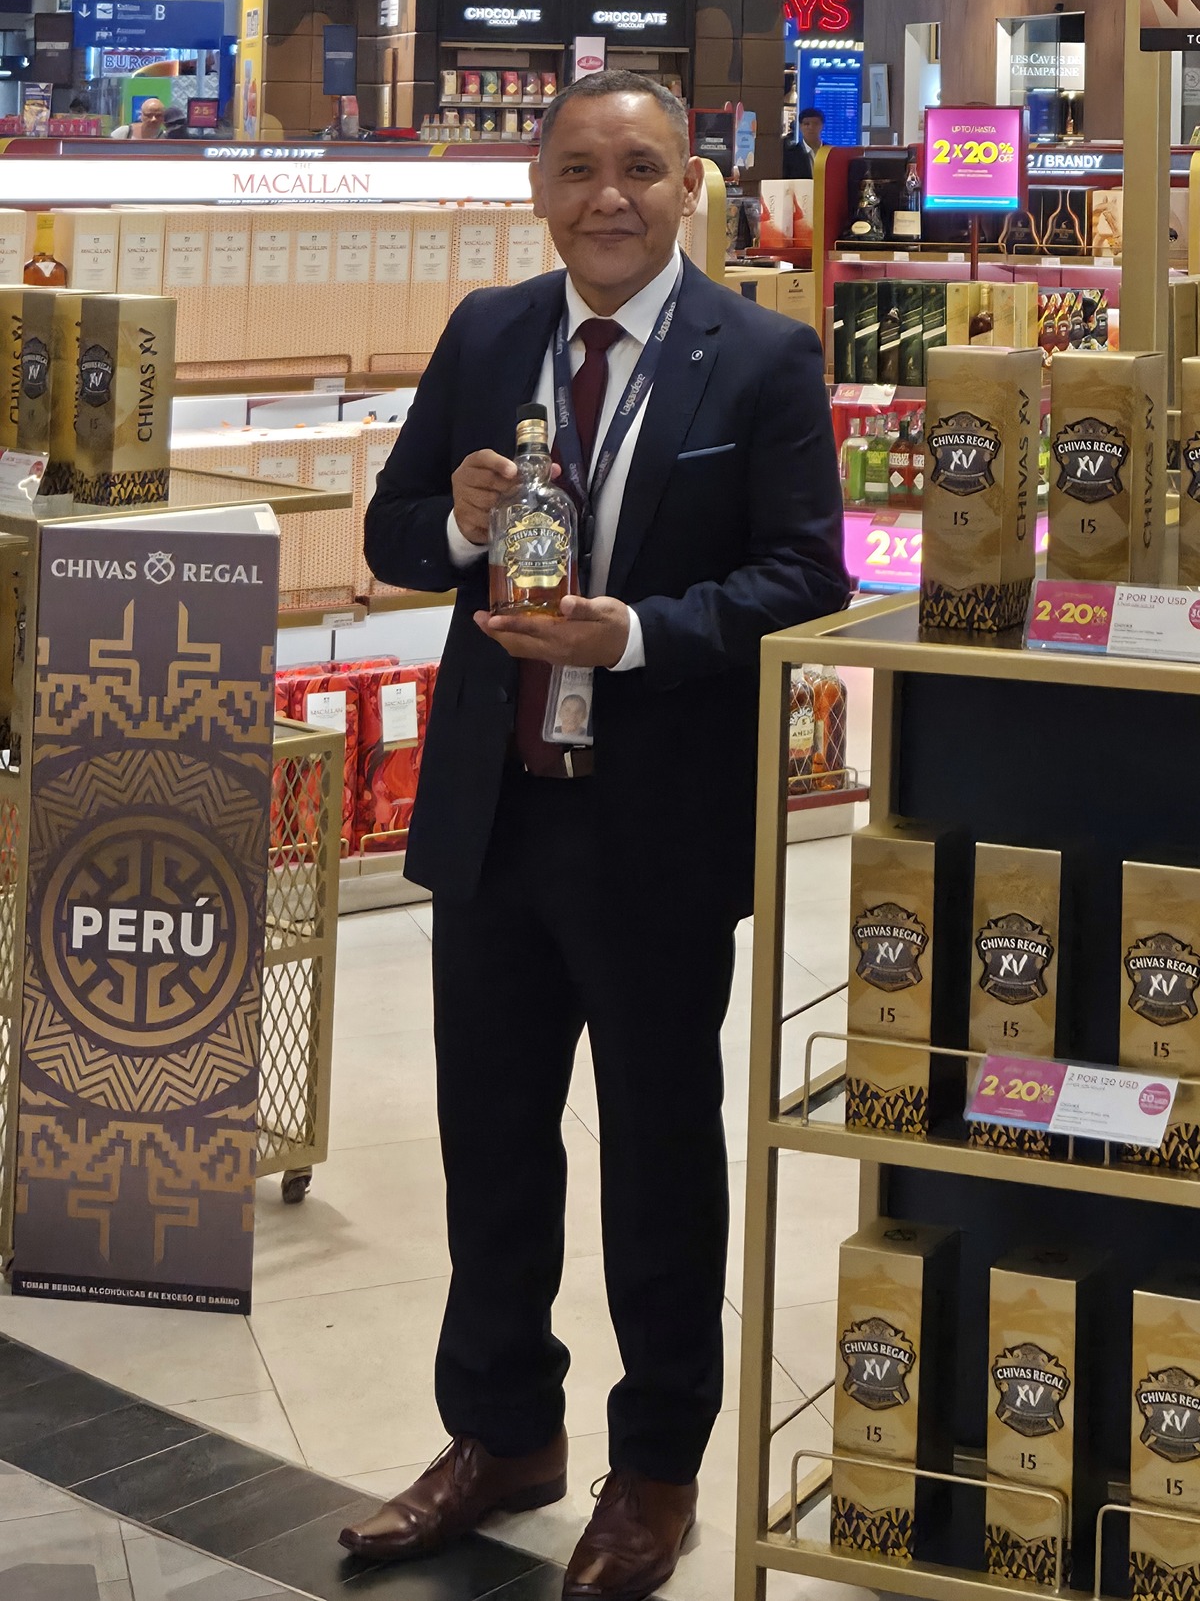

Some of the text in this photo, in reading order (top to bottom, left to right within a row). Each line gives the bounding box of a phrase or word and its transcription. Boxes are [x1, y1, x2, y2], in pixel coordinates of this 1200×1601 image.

[155, 4, 166, 21] B
[466, 7, 541, 22] CHOCOLATE
[595, 10, 668, 25] CHOCOLATE
[1011, 54, 1028, 64] LES
[1012, 66, 1080, 78] CHAMPAGNE
[1045, 154, 1103, 168] BRANDY
[232, 173, 371, 194] MACALLAN
[138, 328, 157, 442] CHIVAS XV
[933, 435, 995, 451] CHIVAS REGAL
[1058, 441, 1123, 458] CHIVAS REGAL
[950, 449, 976, 470] XV
[1077, 455, 1103, 477] XV
[953, 511, 968, 526] 15
[1081, 518, 1096, 534] 15
[507, 529, 538, 544] CHIVAS
[526, 539, 551, 558] XV
[51, 558, 263, 584] CHIVAS REGAL
[1127, 594, 1147, 603] POR
[1150, 595, 1165, 603] 120
[1168, 597, 1187, 605] USD
[72, 897, 215, 957] PERÚ
[857, 926, 923, 945] CHIVAS REGAL
[876, 942, 903, 963] XV
[981, 937, 1047, 957] CHIVAS REGAL
[1000, 953, 1028, 977] XV
[1129, 957, 1198, 978] CHIVAS REGAL
[1149, 973, 1178, 997] XV
[880, 1007, 895, 1023] 15
[1003, 1020, 1019, 1038] 15
[1153, 1041, 1170, 1058] 15
[1077, 1074, 1097, 1083] POR
[1119, 1079, 1138, 1089] USD
[21, 1281, 49, 1289] TOMAR
[148, 1290, 159, 1299] EN
[845, 1343, 910, 1364] CHIVAS REGAL
[863, 1358, 891, 1381] XV
[997, 1368, 1064, 1390] CHIVAS REGAL
[1016, 1384, 1044, 1408] XV
[1141, 1392, 1178, 1404] CHIVAS
[1161, 1409, 1191, 1433] XV
[866, 1424, 882, 1442] 15
[1020, 1452, 1036, 1470] 15
[1166, 1478, 1183, 1496] 15
